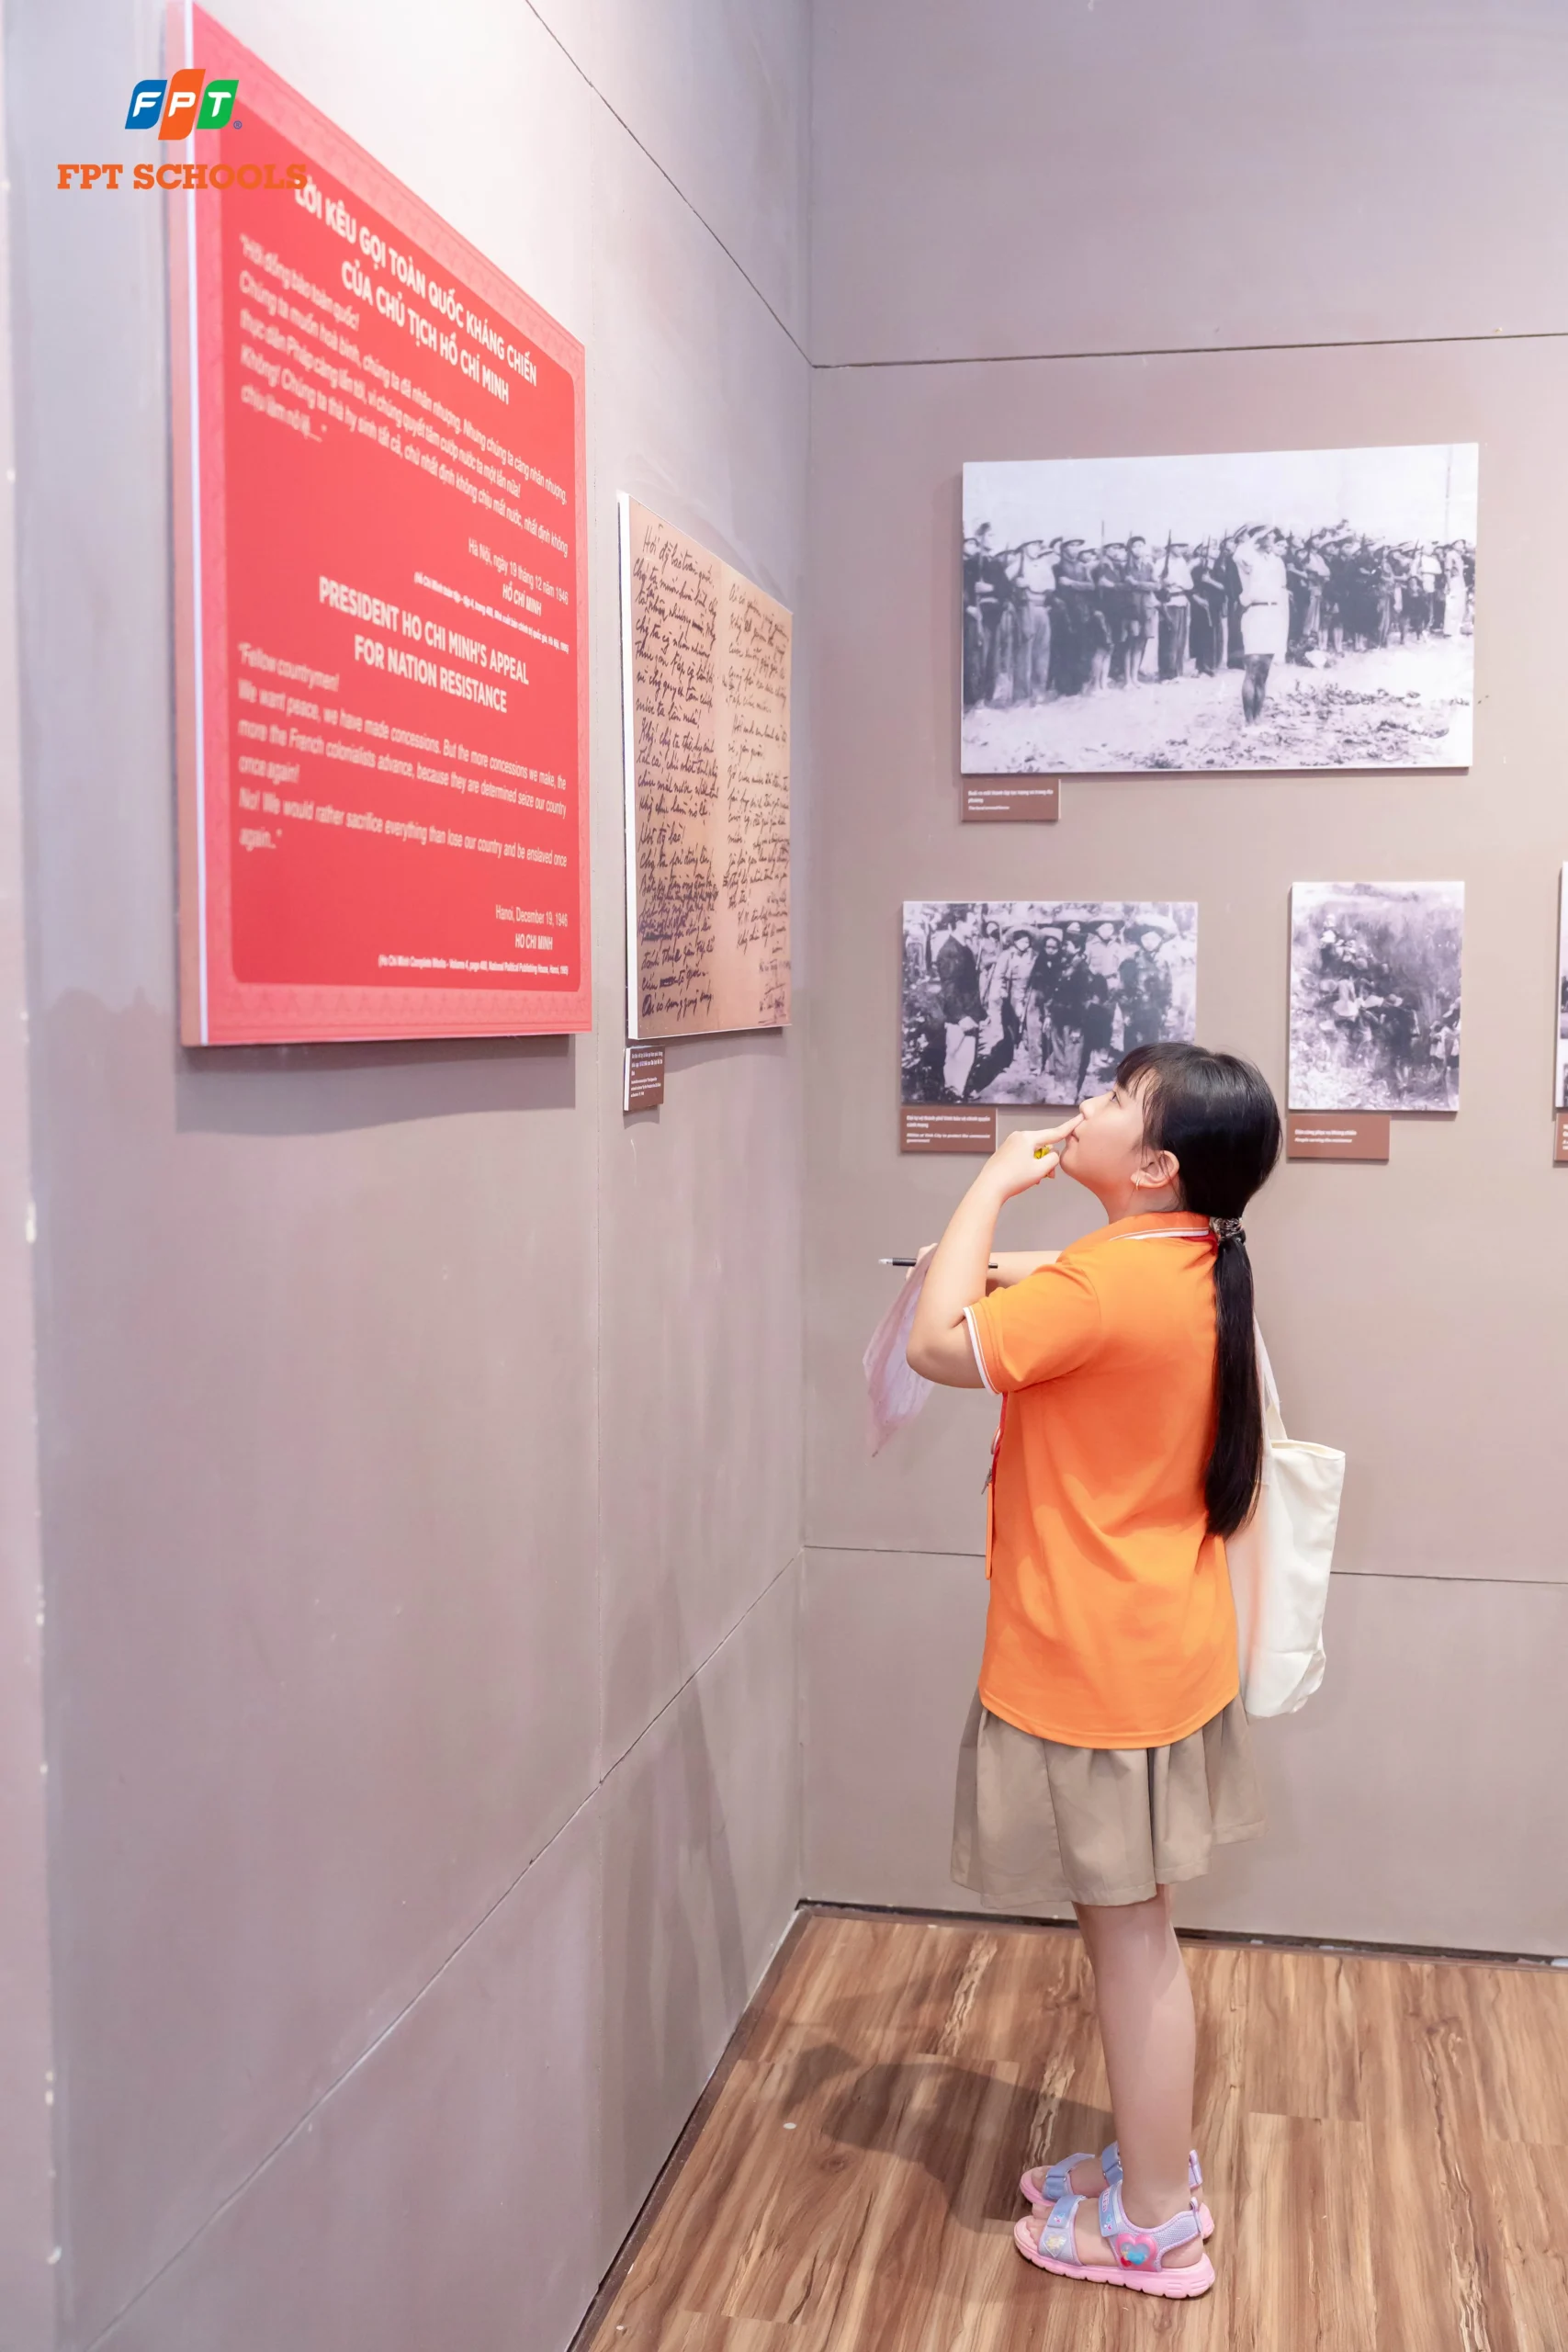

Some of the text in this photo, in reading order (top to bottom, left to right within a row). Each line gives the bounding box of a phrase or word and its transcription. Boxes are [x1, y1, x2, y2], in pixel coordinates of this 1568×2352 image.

[325, 198, 355, 243] KÊU
[359, 226, 385, 269] GỌI
[389, 247, 425, 298] TOÀN
[428, 281, 463, 327] QUỐC
[467, 311, 504, 359] KHÁNG
[507, 345, 536, 386] CHIẾN
[342, 259, 508, 404] CỦA CHỦ TỊCH HỒ CHÍ MINH
[468, 538, 568, 605] Hà Nội, ngày 19 tháng 12 năm 1946
[502, 581, 541, 616] HỒ CHÍ MINH
[320, 576, 399, 631] PRESIDENT
[402, 611, 422, 640] HO
[424, 621, 445, 650] CHI
[490, 649, 528, 684] APPEAL
[355, 635, 506, 712] FOR NATION RESISTANCE
[238, 719, 566, 819] more the French colonialists advance, because they are determined seize our country
[239, 679, 566, 789] We want peace, we have made concessions. But the more concessions we make, the
[263, 792, 280, 814] We
[283, 801, 313, 820] would
[315, 805, 344, 825] rather
[345, 812, 383, 832] sacrifice
[385, 820, 427, 844] everything
[429, 826, 446, 843] than
[447, 829, 462, 847] lose
[465, 836, 476, 849] our
[478, 839, 502, 858] country
[503, 842, 515, 856] and
[517, 843, 525, 859] be
[526, 847, 552, 864] enslaved
[554, 854, 566, 866] once
[496, 905, 514, 922] Hanoi,
[516, 907, 544, 923] December
[556, 912, 567, 926] 1946
[515, 933, 552, 949] HO CHI MINH
